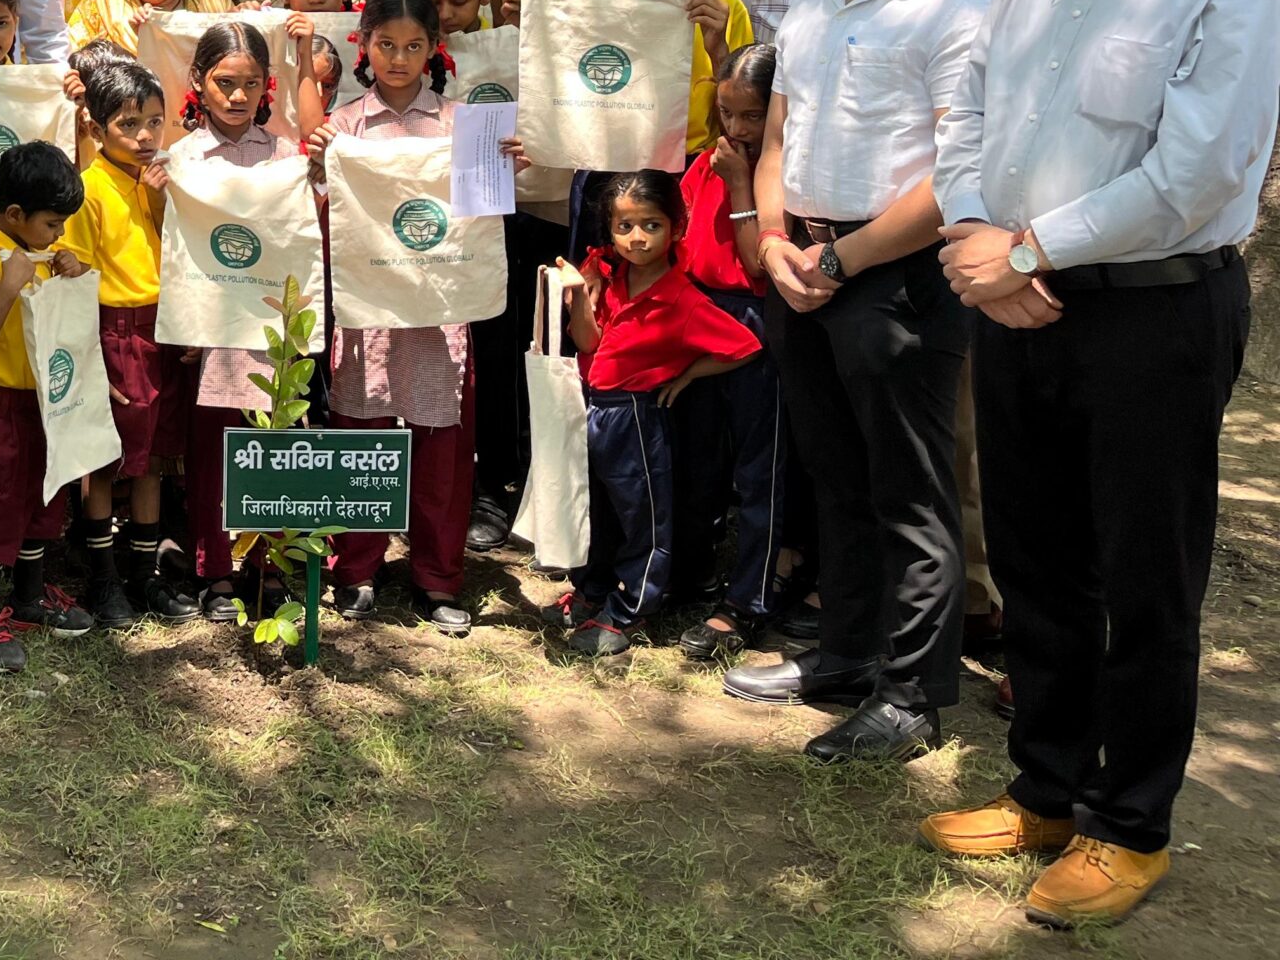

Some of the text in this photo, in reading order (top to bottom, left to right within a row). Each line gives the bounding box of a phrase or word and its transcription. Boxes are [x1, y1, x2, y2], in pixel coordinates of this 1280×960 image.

[596, 100, 625, 109] POLLUTION
[627, 102, 655, 111] GLOBALLY
[370, 254, 474, 266] ENDING PLASTIC POLLUTION GLOBALLY
[205, 273, 227, 282] PLASTIC
[228, 275, 258, 284] POLLUTION
[258, 278, 285, 288] GLOBALLY
[233, 440, 402, 472] श्री सविन बसंल
[349, 473, 401, 489] आई.ए.एस.
[241, 495, 392, 523] जिलाधिकारी देहरादून
